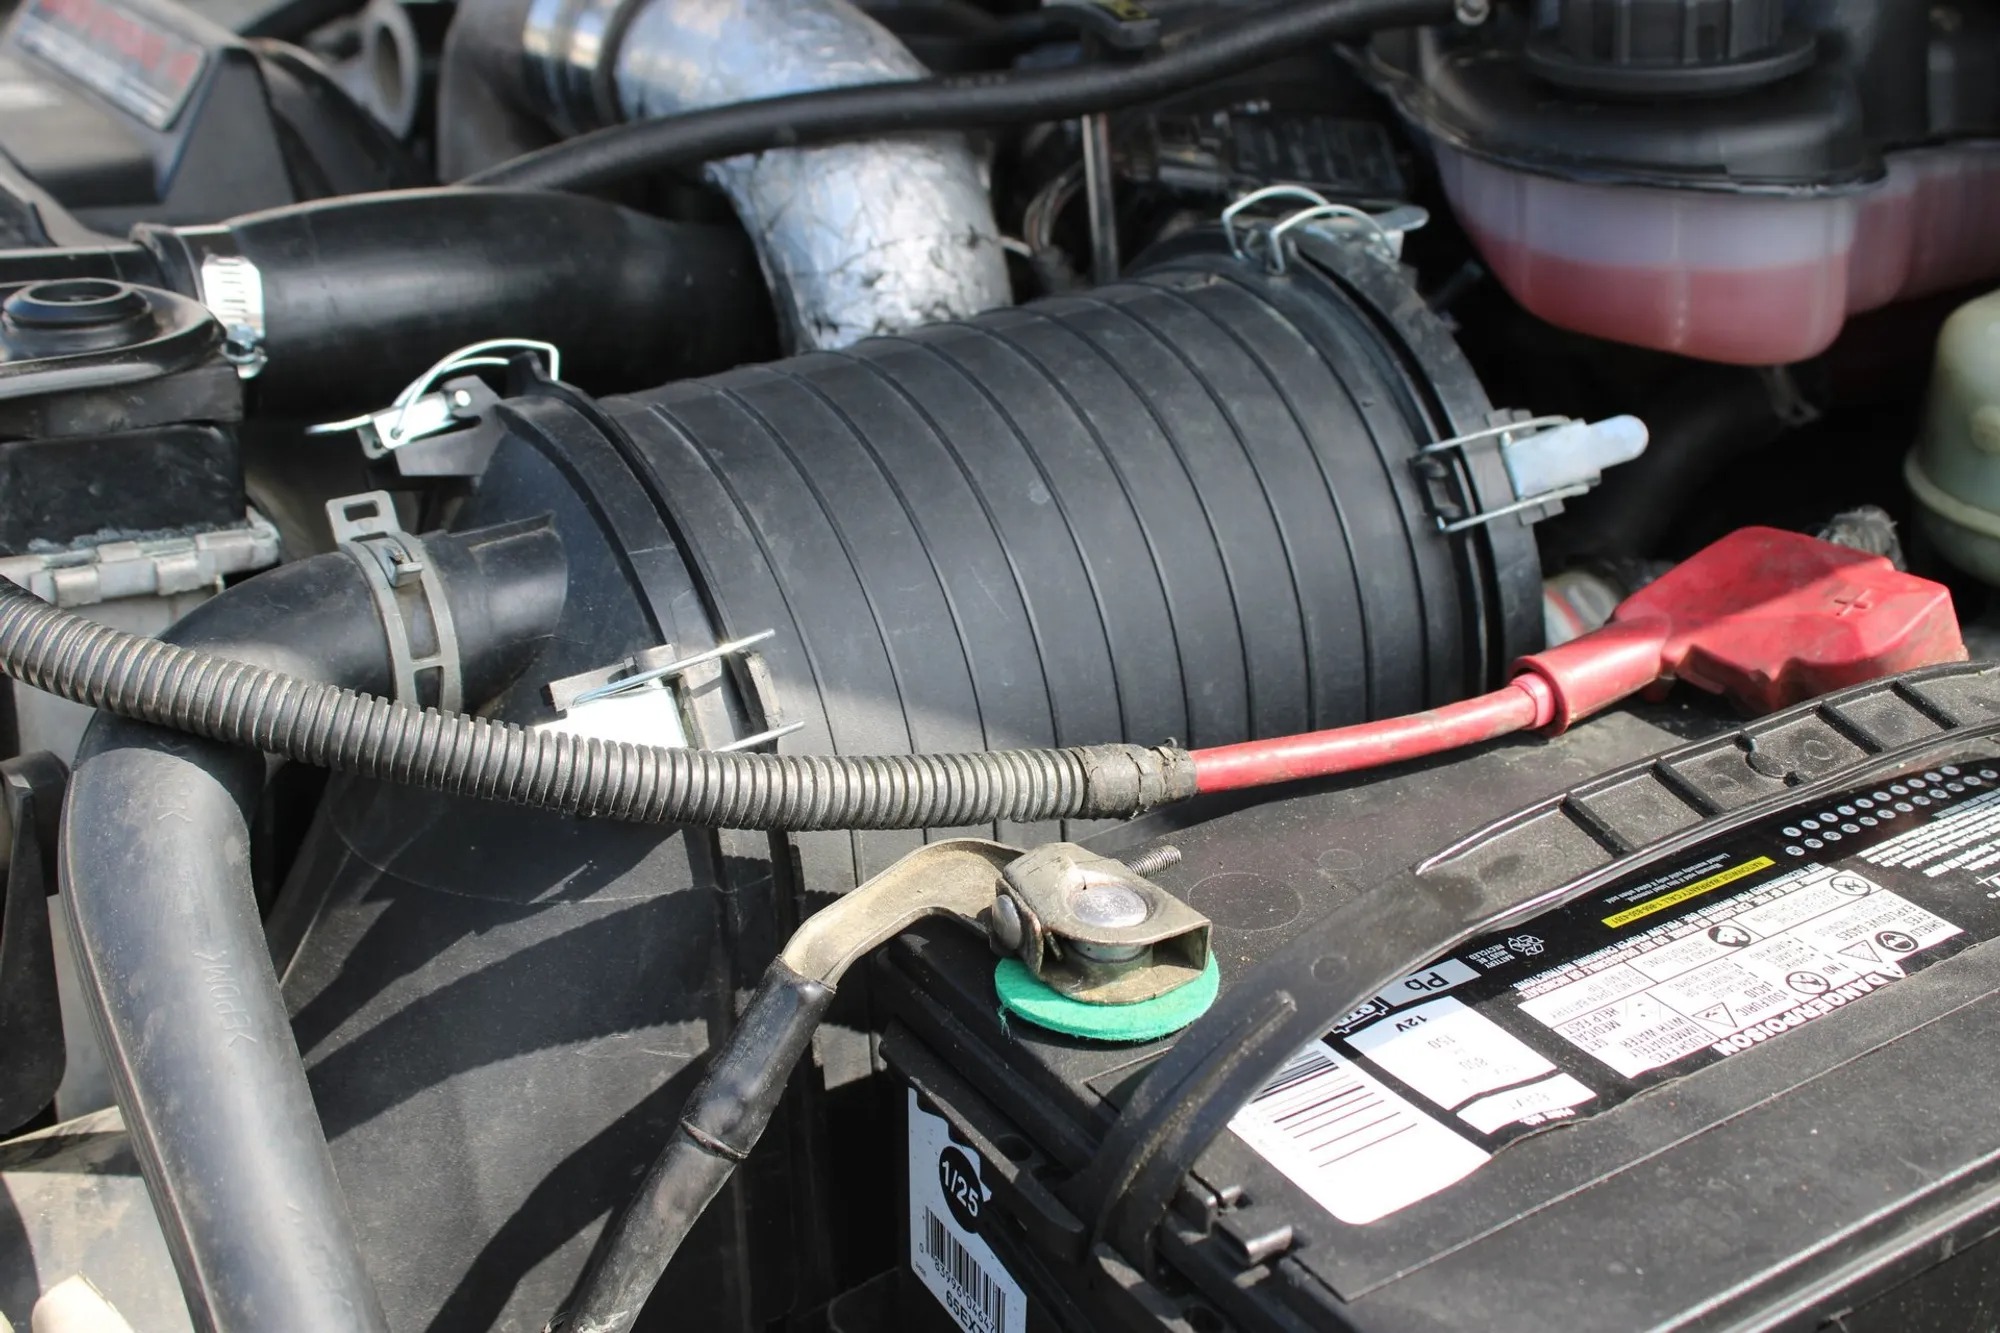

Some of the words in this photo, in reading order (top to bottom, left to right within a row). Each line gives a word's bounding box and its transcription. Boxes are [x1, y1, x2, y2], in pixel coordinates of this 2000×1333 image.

[1681, 878, 1720, 896] WARRANTY
[1659, 893, 1682, 903] CALL
[1864, 903, 1916, 928] EXPLOSIVE
[1902, 911, 1931, 926] EYES
[1835, 923, 1869, 941] GASES
[1909, 919, 1945, 937] SHIELD
[1465, 942, 1504, 961] RECYCLED.
[1475, 956, 1489, 965] BE
[1485, 949, 1508, 960] MUST
[1482, 953, 1514, 969] BATTERY
[1820, 963, 1842, 975] NO
[1402, 971, 1448, 995] Pb
[1742, 983, 1771, 998] ACID
[1734, 991, 1786, 1016] SULFURIC
[1589, 1007, 1618, 1022] HELP
[1711, 973, 1888, 1053] DANGER/POISON
[1391, 1013, 1428, 1032] 12V
[1562, 1018, 1591, 1034] FAST
[1571, 1019, 1620, 1043] MEDICAL
[1655, 1016, 1686, 1032] WITH
[1425, 1033, 1456, 1050] 150
[1583, 1038, 1608, 1051] GET
[1618, 1028, 1658, 1048] WATER
[1627, 1024, 1700, 1058] IMMEDIATELY
[1676, 1032, 1713, 1051] FLUSH
[1648, 1047, 1680, 1063] EYES
[942, 1160, 979, 1217] 1/25
